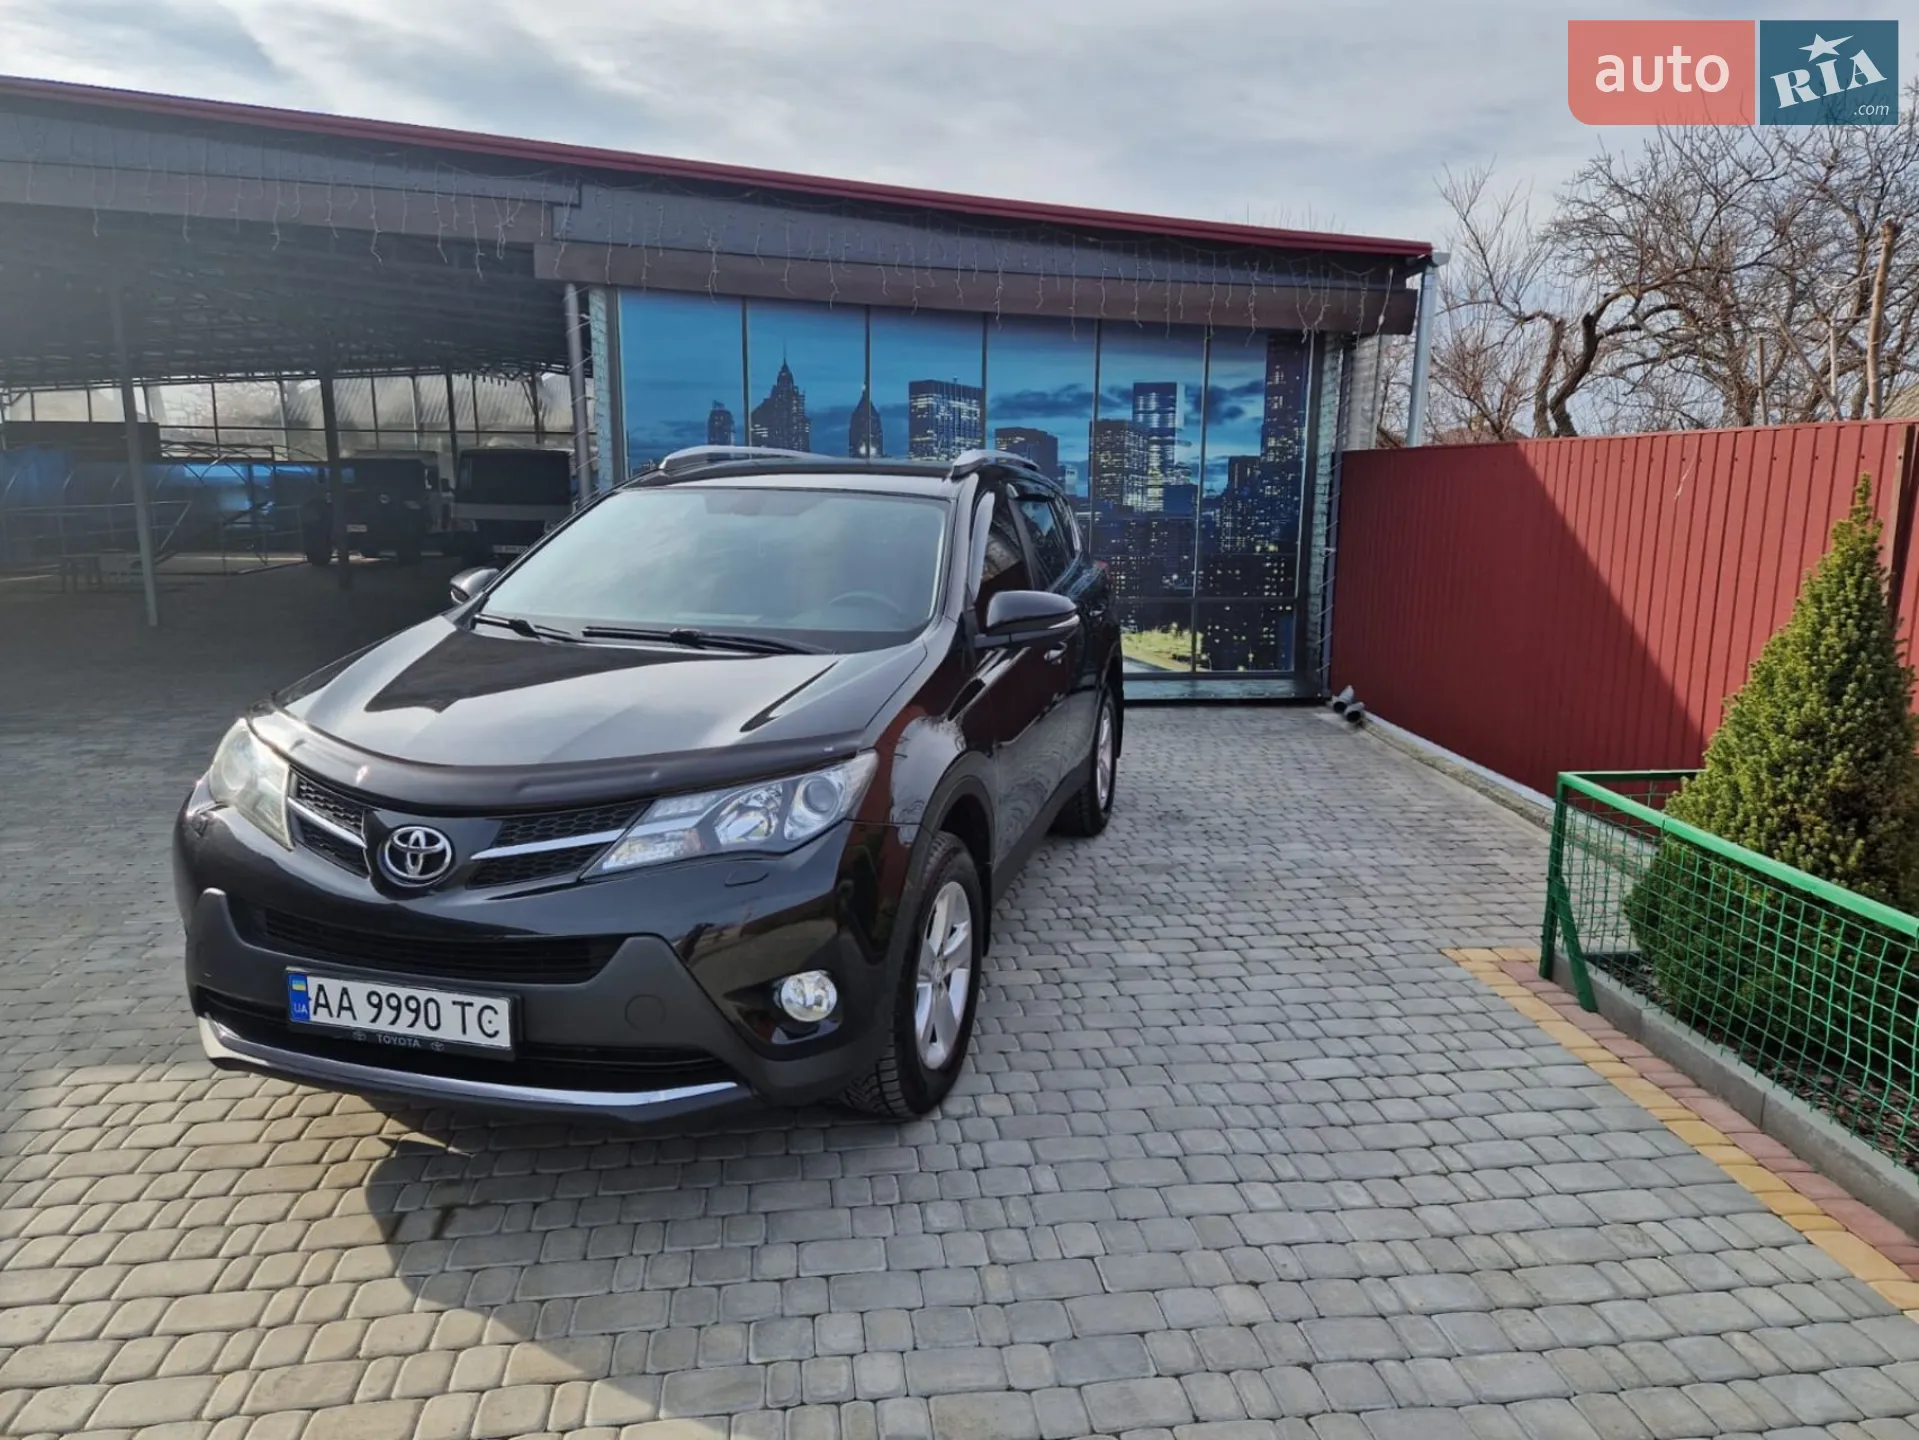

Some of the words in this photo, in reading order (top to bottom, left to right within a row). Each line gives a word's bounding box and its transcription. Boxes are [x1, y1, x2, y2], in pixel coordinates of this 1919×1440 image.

[294, 1003, 308, 1015] UA
[313, 984, 357, 1021] AA
[366, 990, 441, 1031] 9990
[451, 1000, 500, 1038] TC
[376, 1033, 421, 1049] TOYOTA
